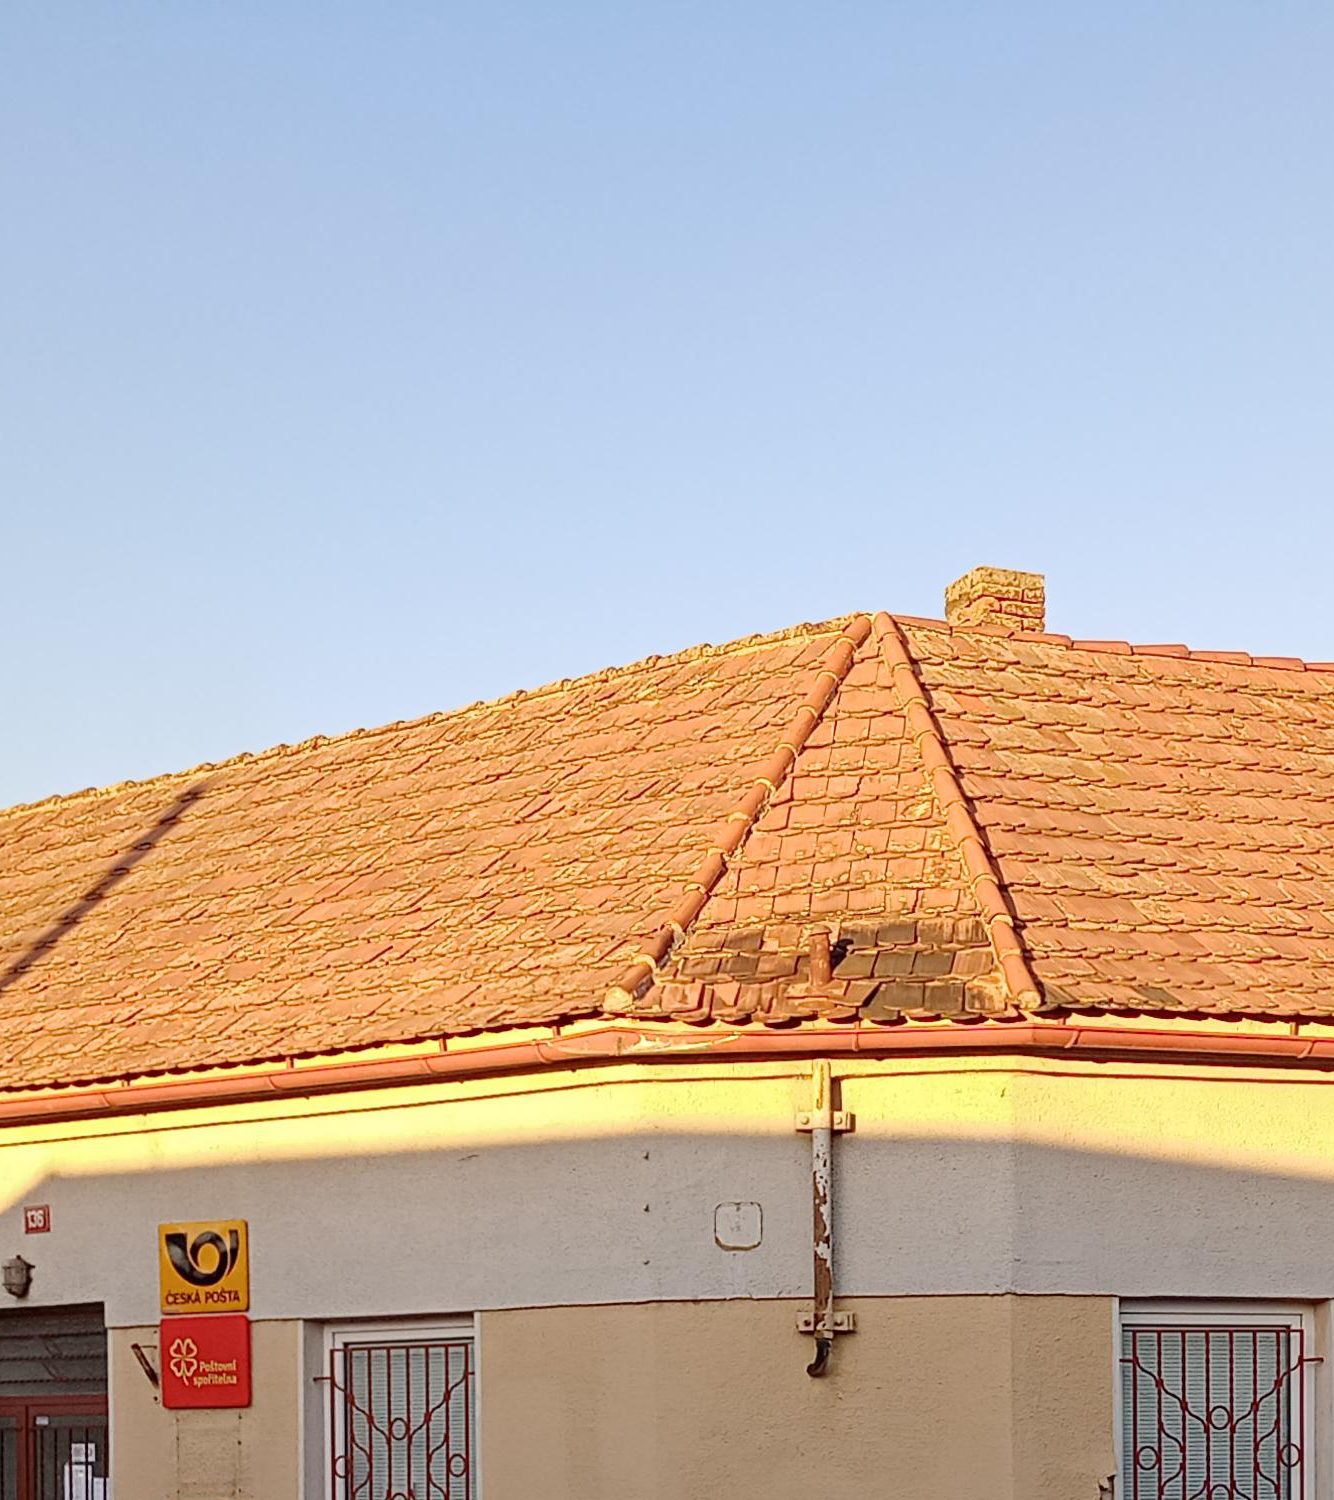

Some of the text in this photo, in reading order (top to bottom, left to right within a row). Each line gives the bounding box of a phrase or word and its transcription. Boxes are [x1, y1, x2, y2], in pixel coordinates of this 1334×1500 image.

[27, 1210, 44, 1228] 136
[165, 1287, 240, 1305] ČESKÁ POŠTA
[199, 1359, 237, 1373] Poštovní
[193, 1373, 237, 1388] spořitelna
